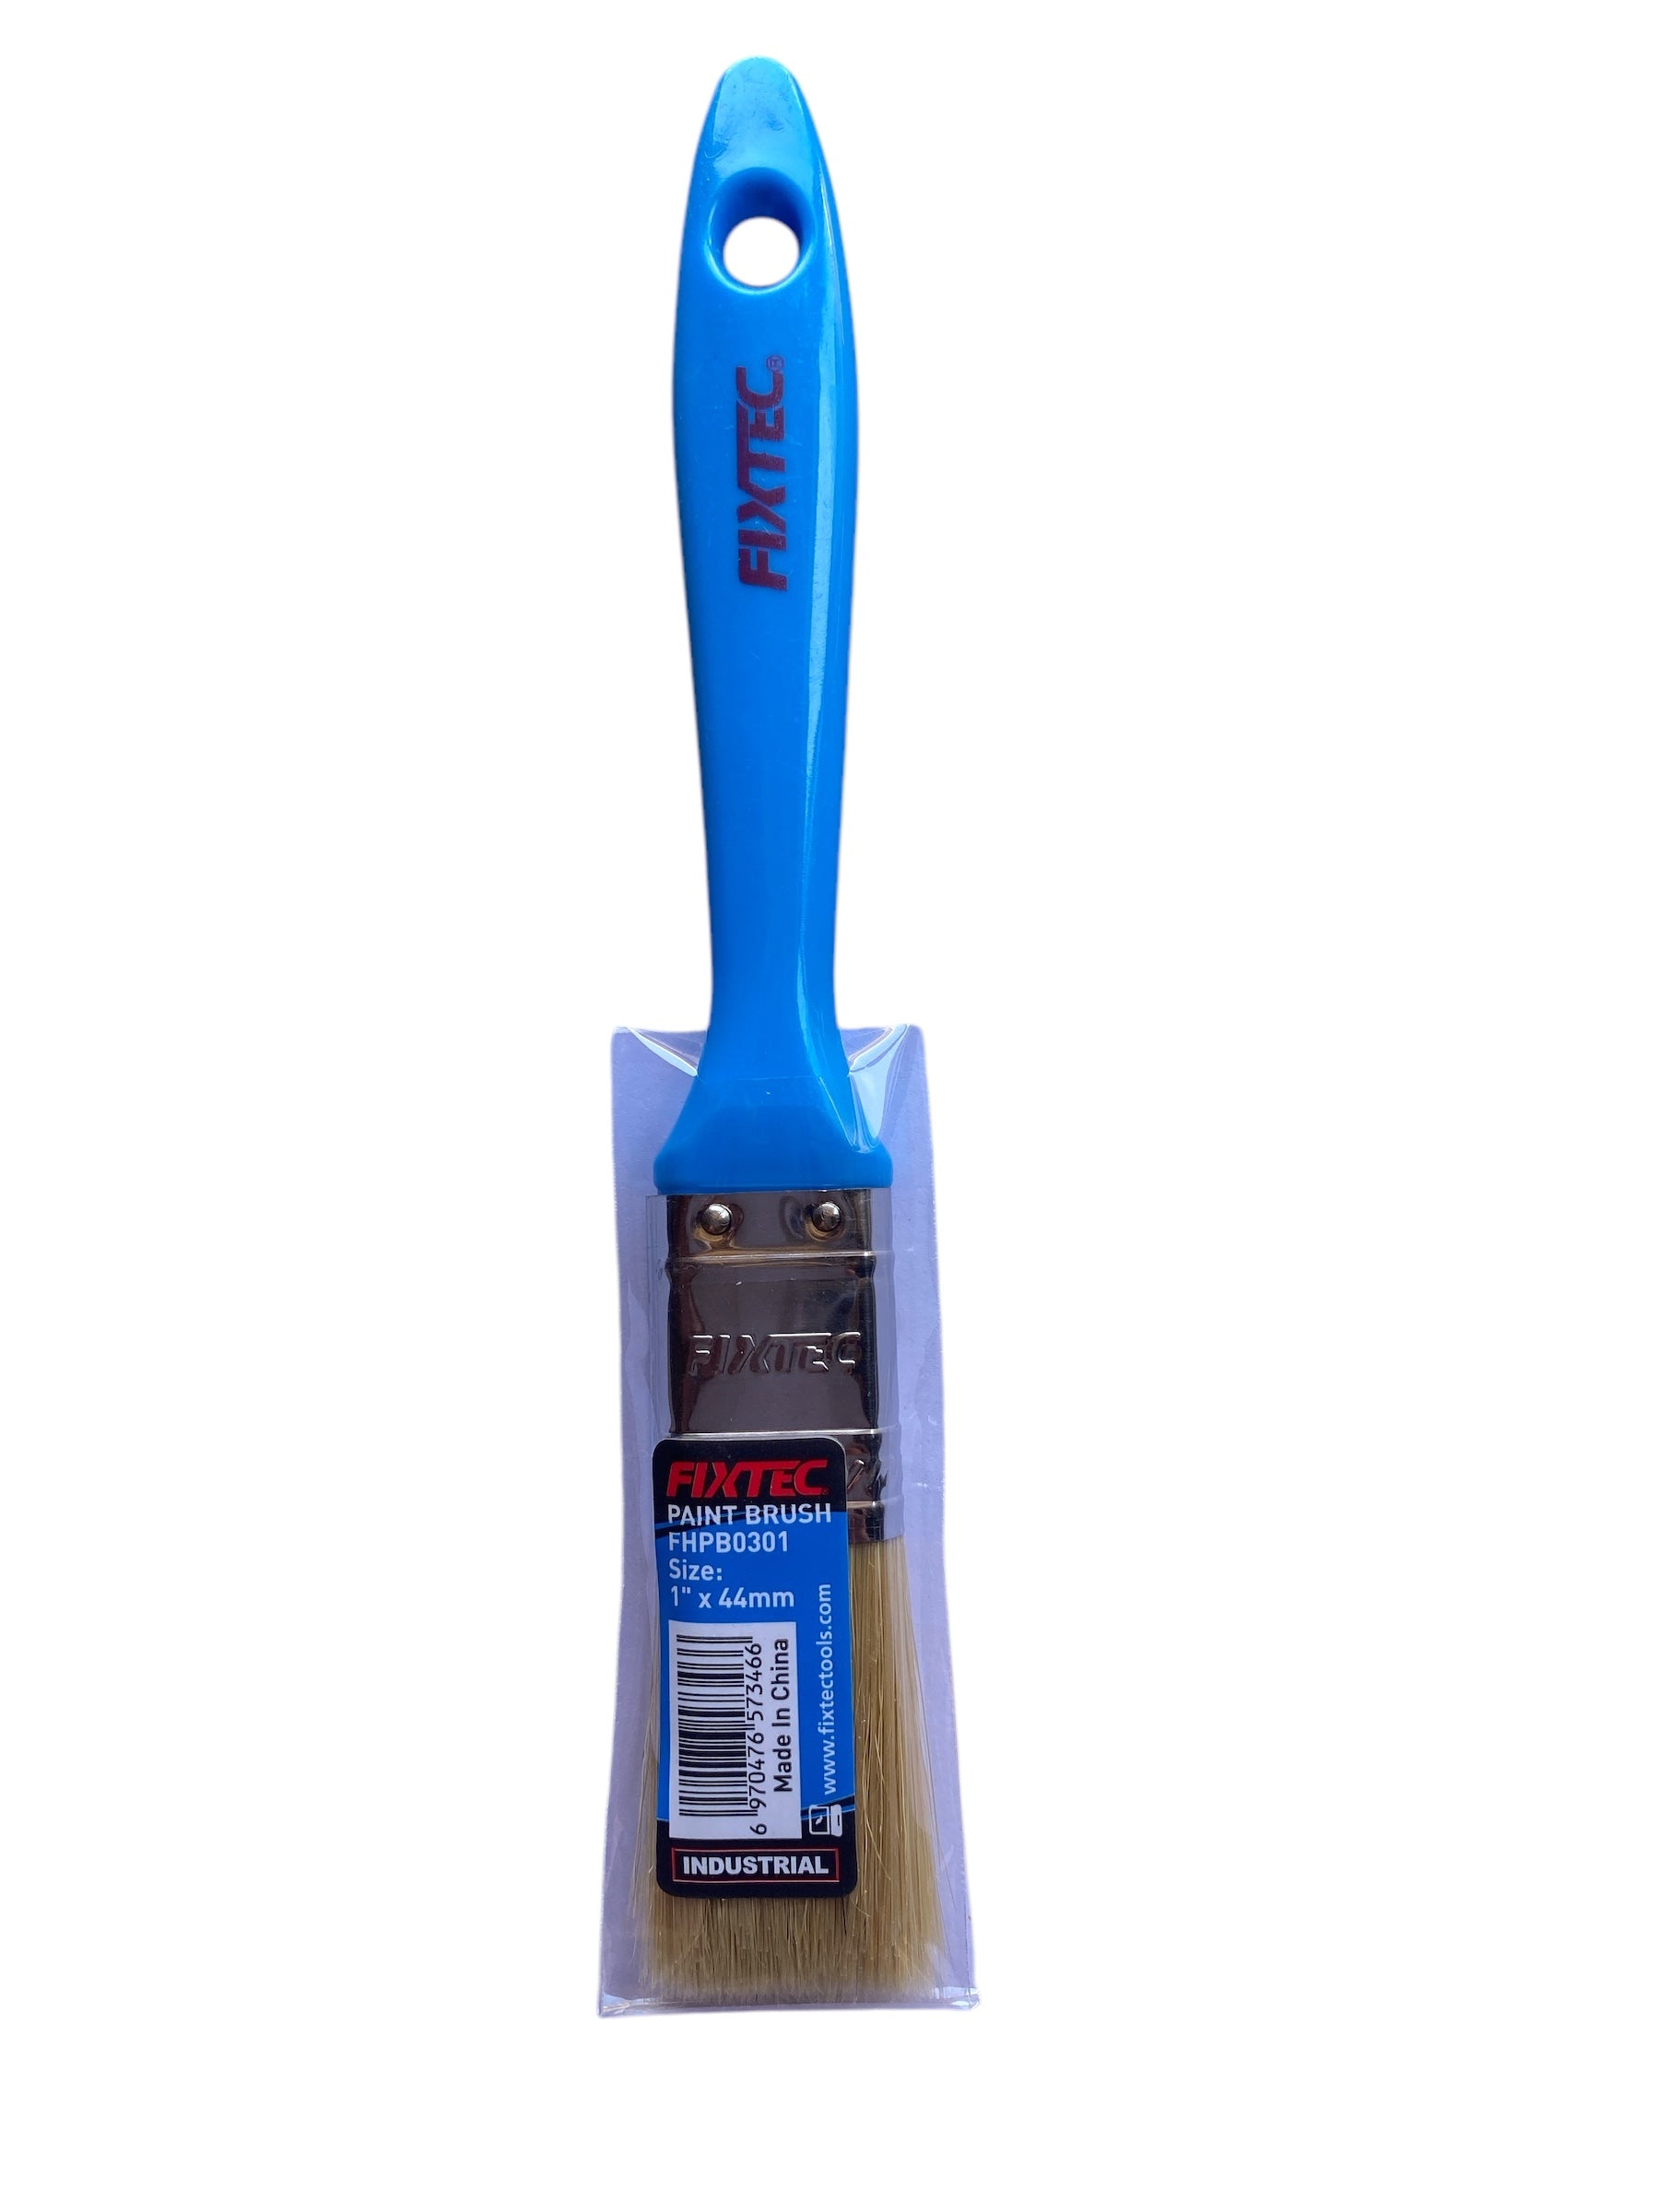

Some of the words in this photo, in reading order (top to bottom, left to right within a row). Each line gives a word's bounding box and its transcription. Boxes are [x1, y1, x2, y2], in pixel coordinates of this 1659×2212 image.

[690, 1333, 862, 1375] FIXTEC
[667, 1504, 737, 1525] PAINT
[745, 1502, 831, 1524] BRUSH
[668, 1531, 789, 1553] FHPB0301
[668, 1558, 724, 1581] Size:
[670, 1585, 691, 1606] 1"
[698, 1592, 712, 1608] x
[718, 1587, 795, 1609] 44mm
[771, 1638, 790, 1700] China
[745, 1642, 765, 1722] 573466
[818, 1583, 838, 1795] www.fixtectools.com
[771, 1707, 792, 1728] In
[747, 1731, 769, 1810] 970476
[773, 1734, 794, 1794] Made
[749, 1823, 768, 1835] 6
[682, 1855, 830, 1877] INDUSTRIAL
